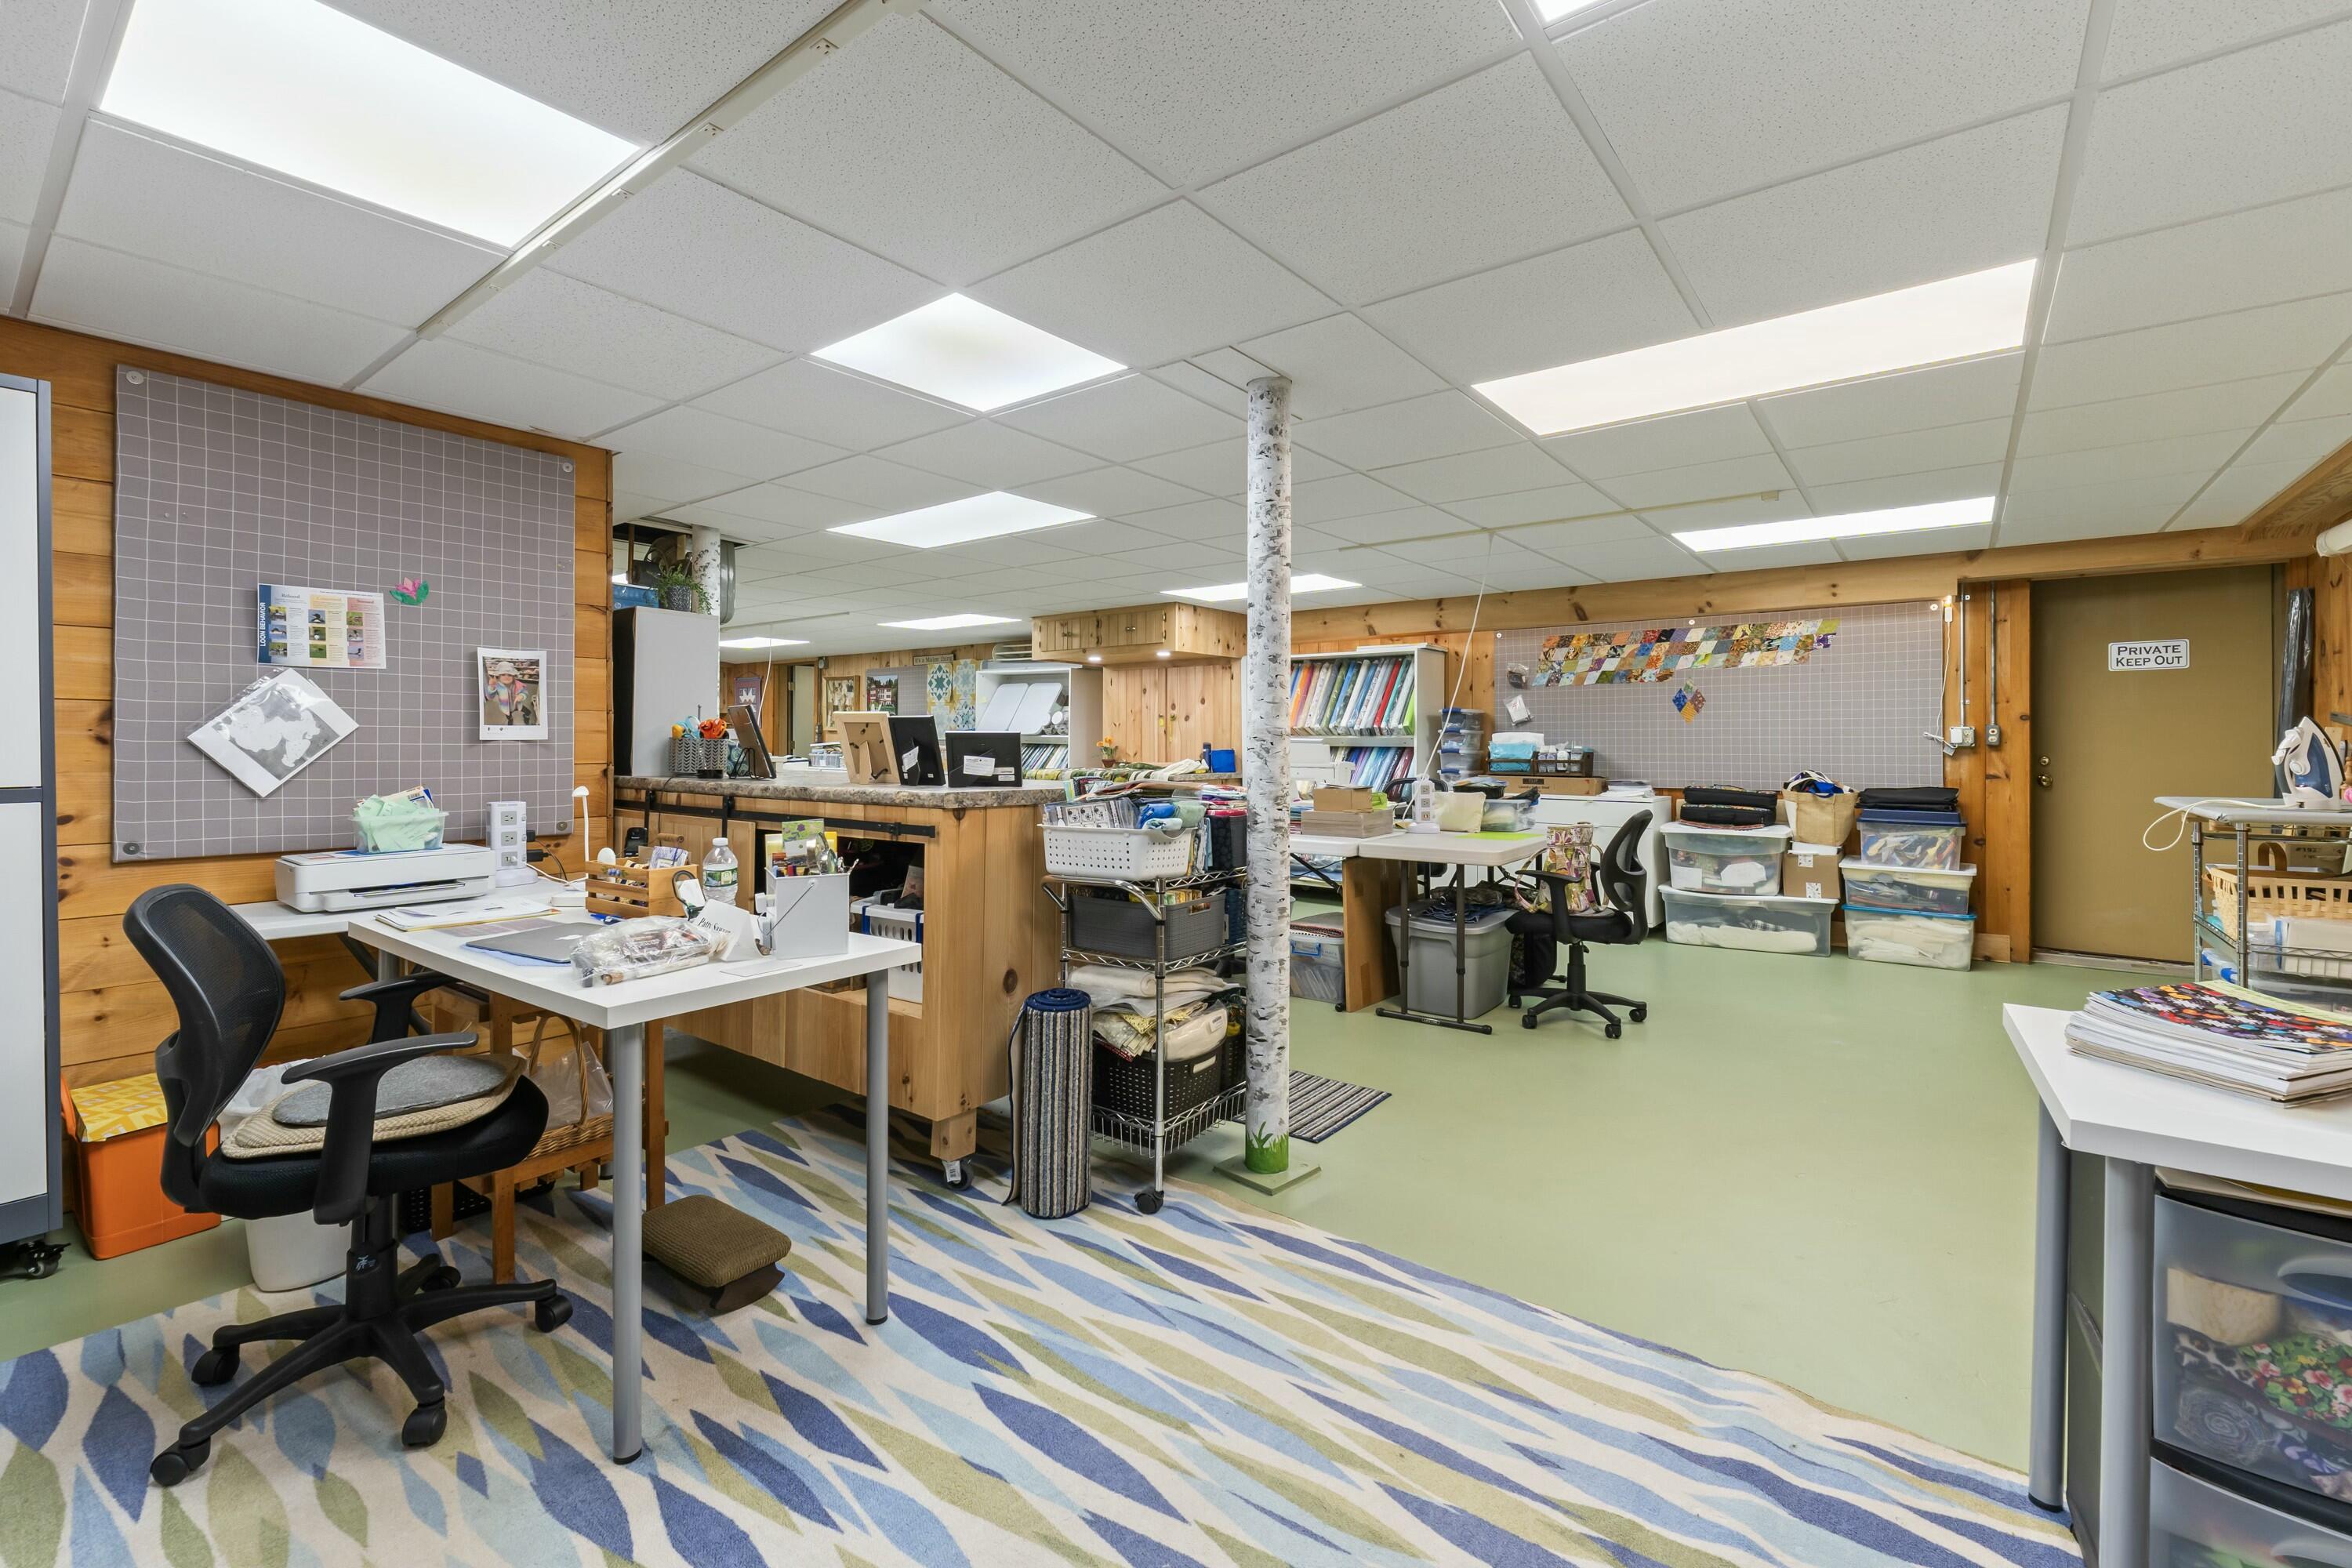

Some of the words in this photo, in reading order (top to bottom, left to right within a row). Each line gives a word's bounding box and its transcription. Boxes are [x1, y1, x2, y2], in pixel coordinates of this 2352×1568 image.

[2118, 644, 2181, 656] PRIVATE
[2116, 657, 2151, 667] KEEP
[2154, 655, 2183, 666] OUT
